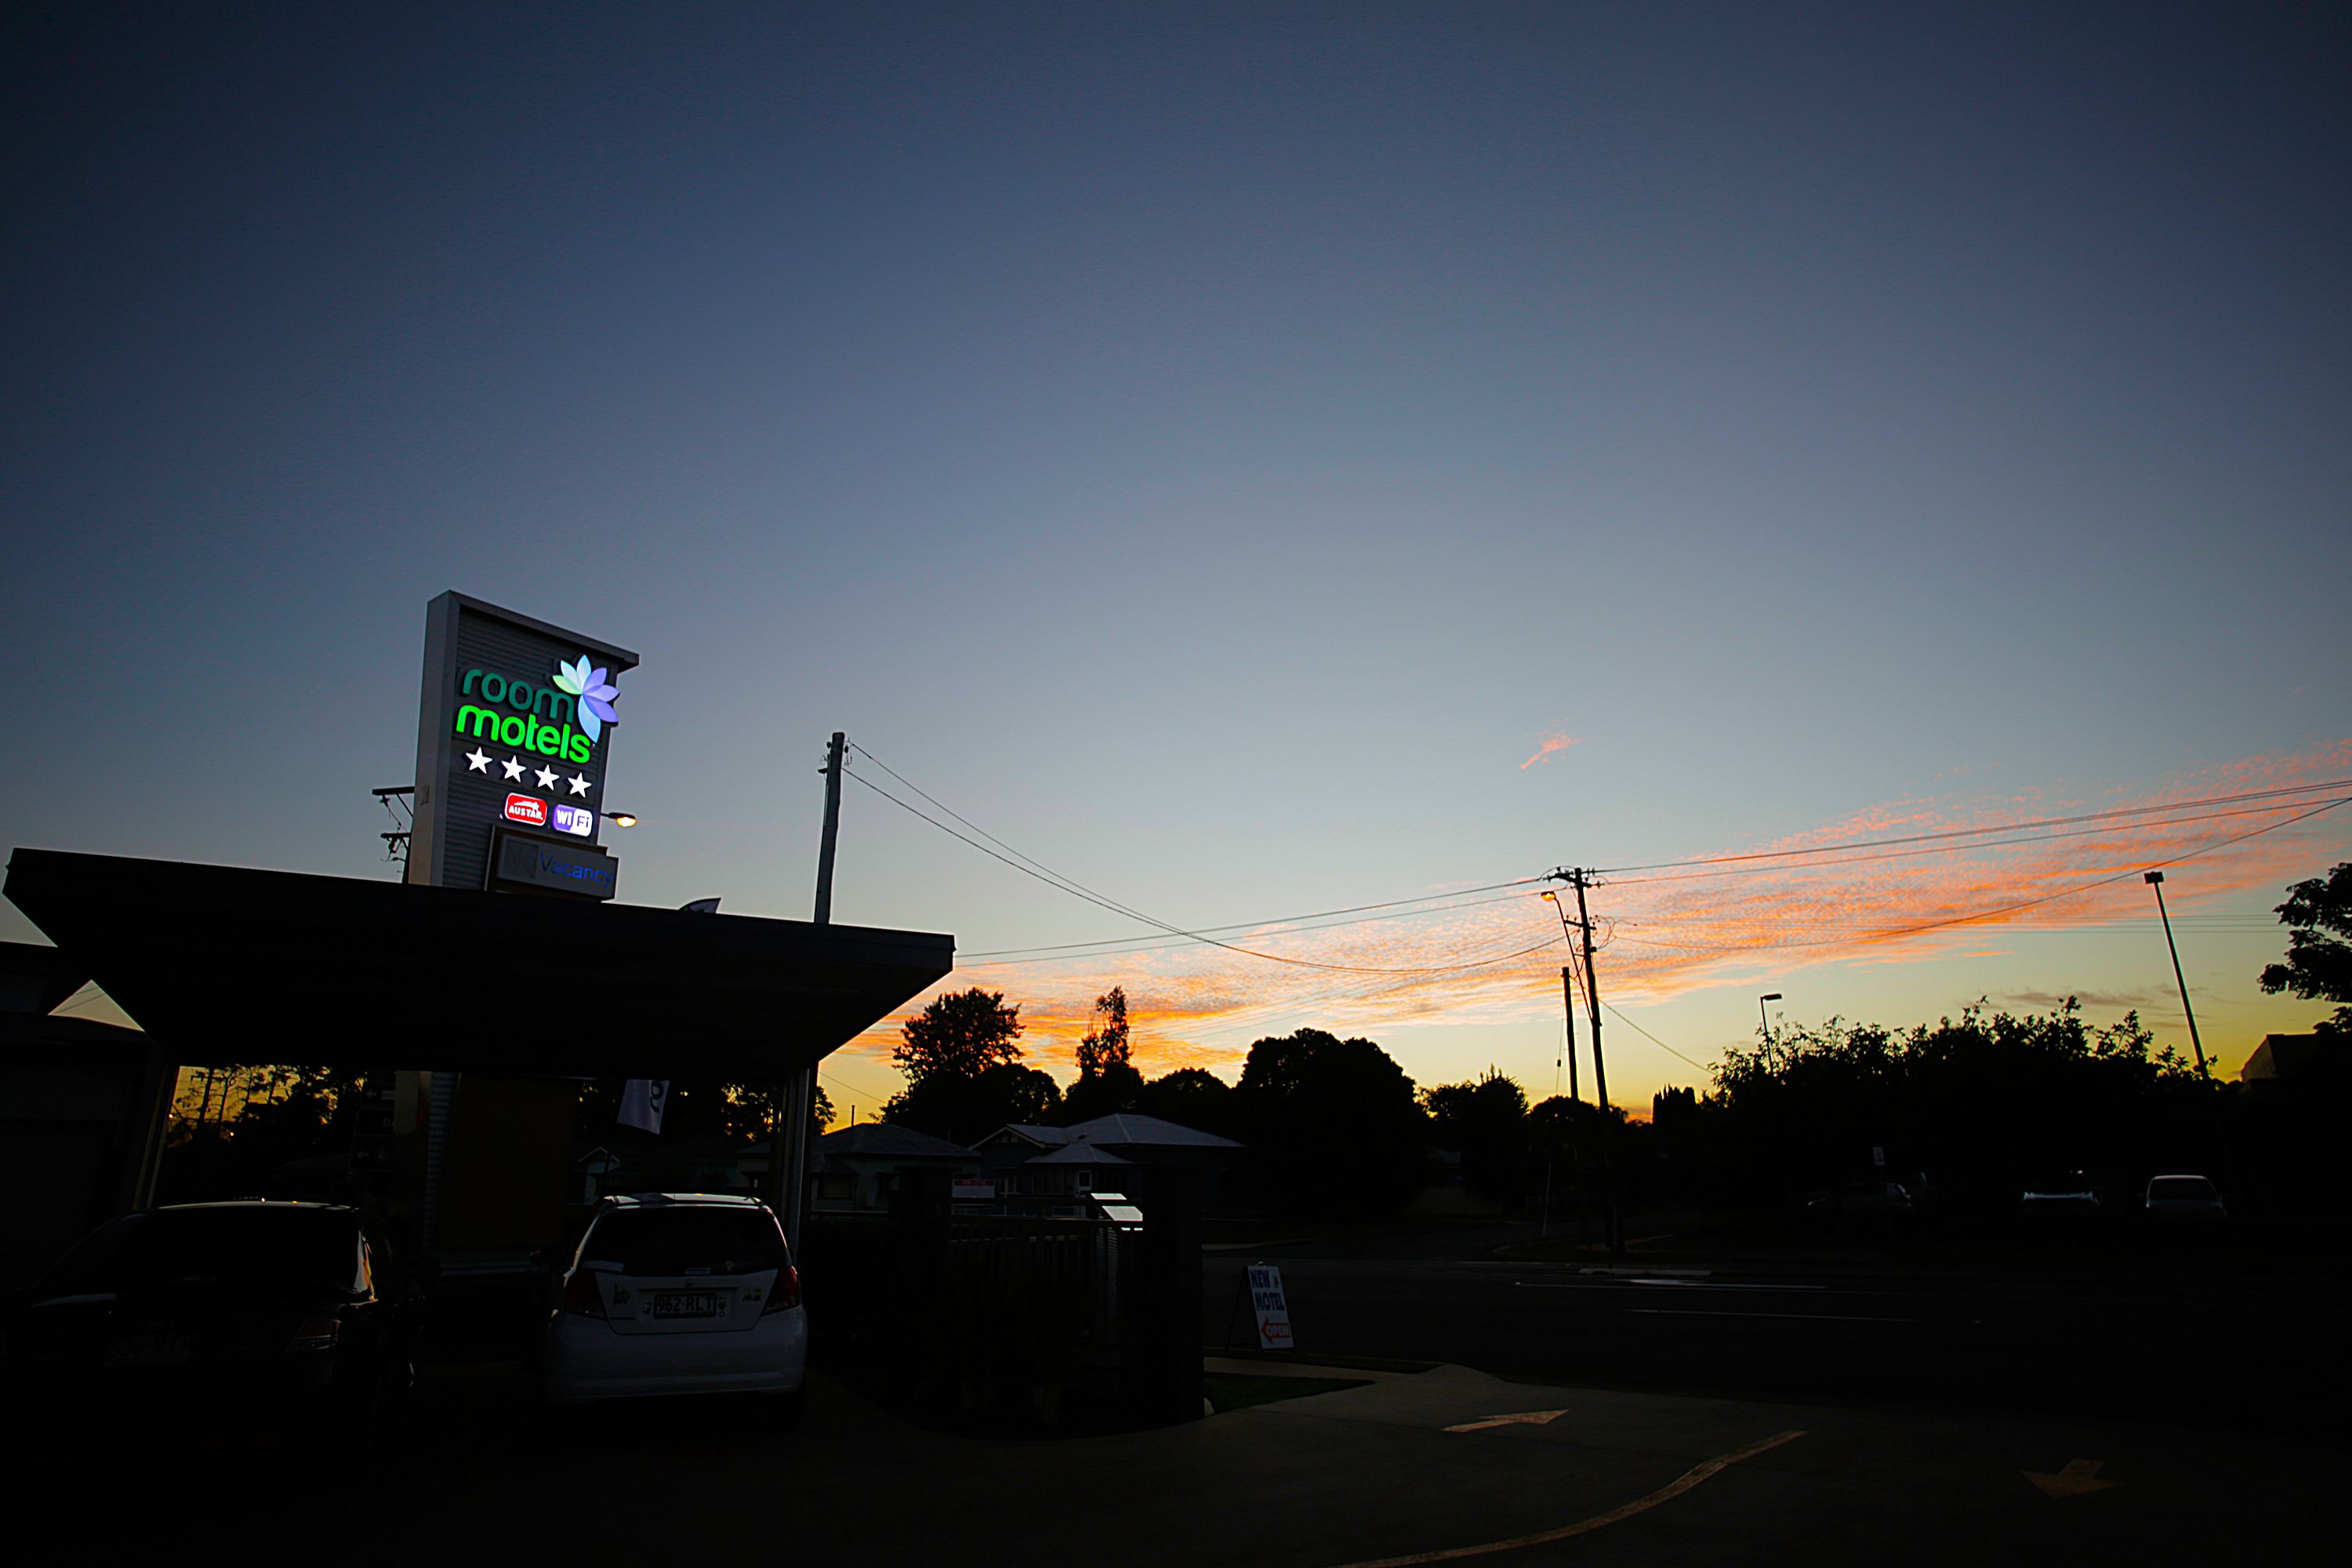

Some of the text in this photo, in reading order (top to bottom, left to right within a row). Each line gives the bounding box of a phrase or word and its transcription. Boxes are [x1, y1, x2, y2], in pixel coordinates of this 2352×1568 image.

[463, 668, 575, 723] room
[456, 705, 590, 764] motels
[540, 854, 615, 888] Vacancy
[1250, 1269, 1270, 1288] NEW
[1254, 1291, 1285, 1311] MOTEL
[1266, 1324, 1291, 1337] OPEN
